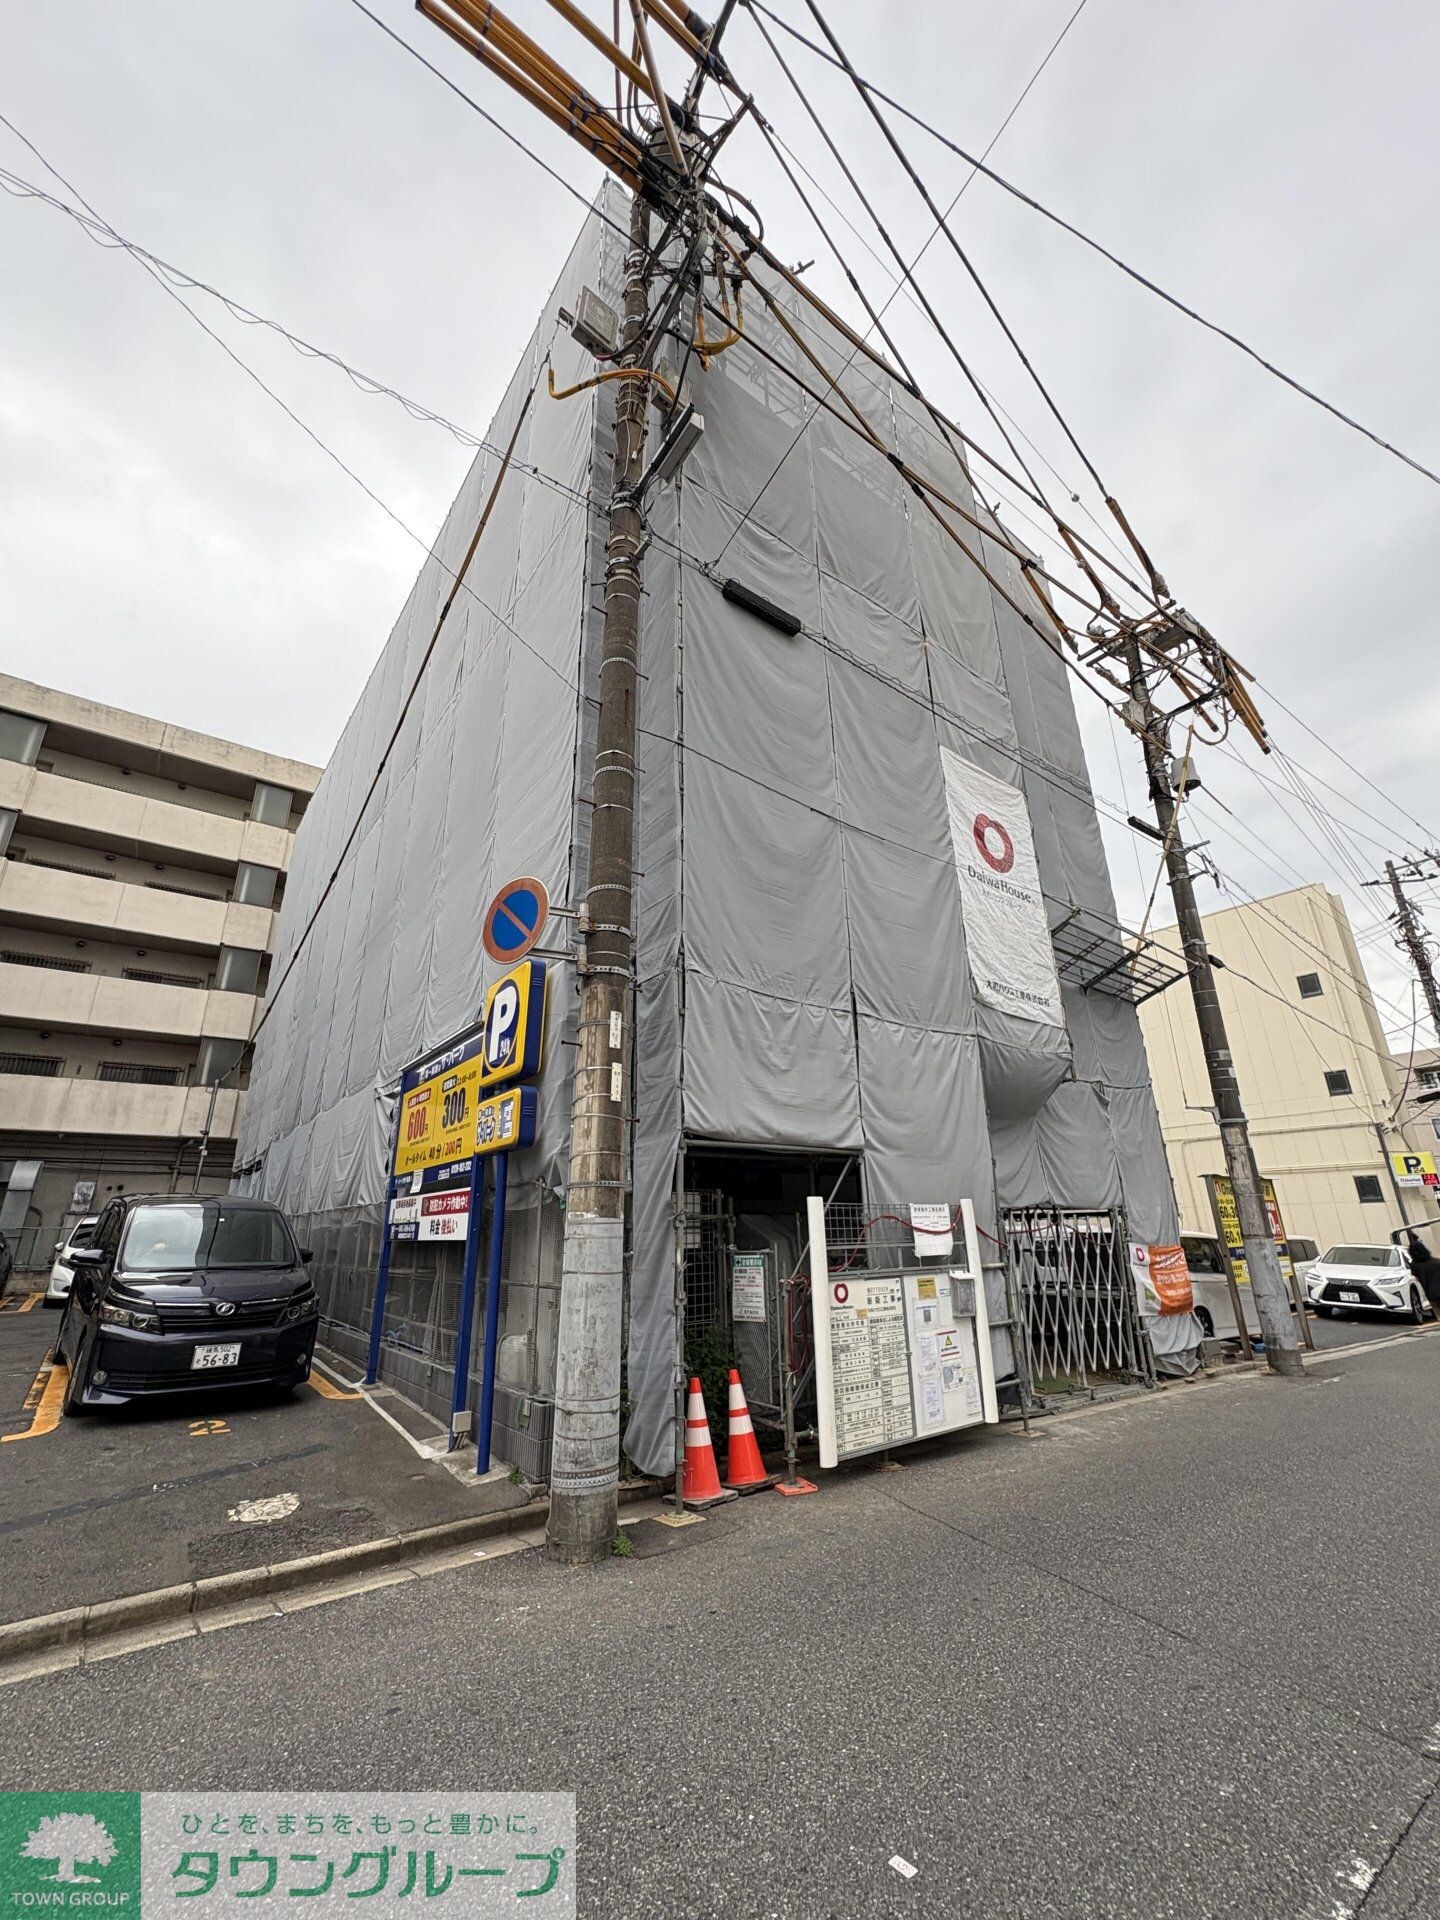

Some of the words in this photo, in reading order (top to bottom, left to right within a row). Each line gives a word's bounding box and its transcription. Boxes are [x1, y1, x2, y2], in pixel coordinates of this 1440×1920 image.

[489, 986, 517, 1063] P
[1403, 1156, 1422, 1174] P
[202, 1352, 237, 1367] 56-83
[188, 1420, 231, 1436] 2
